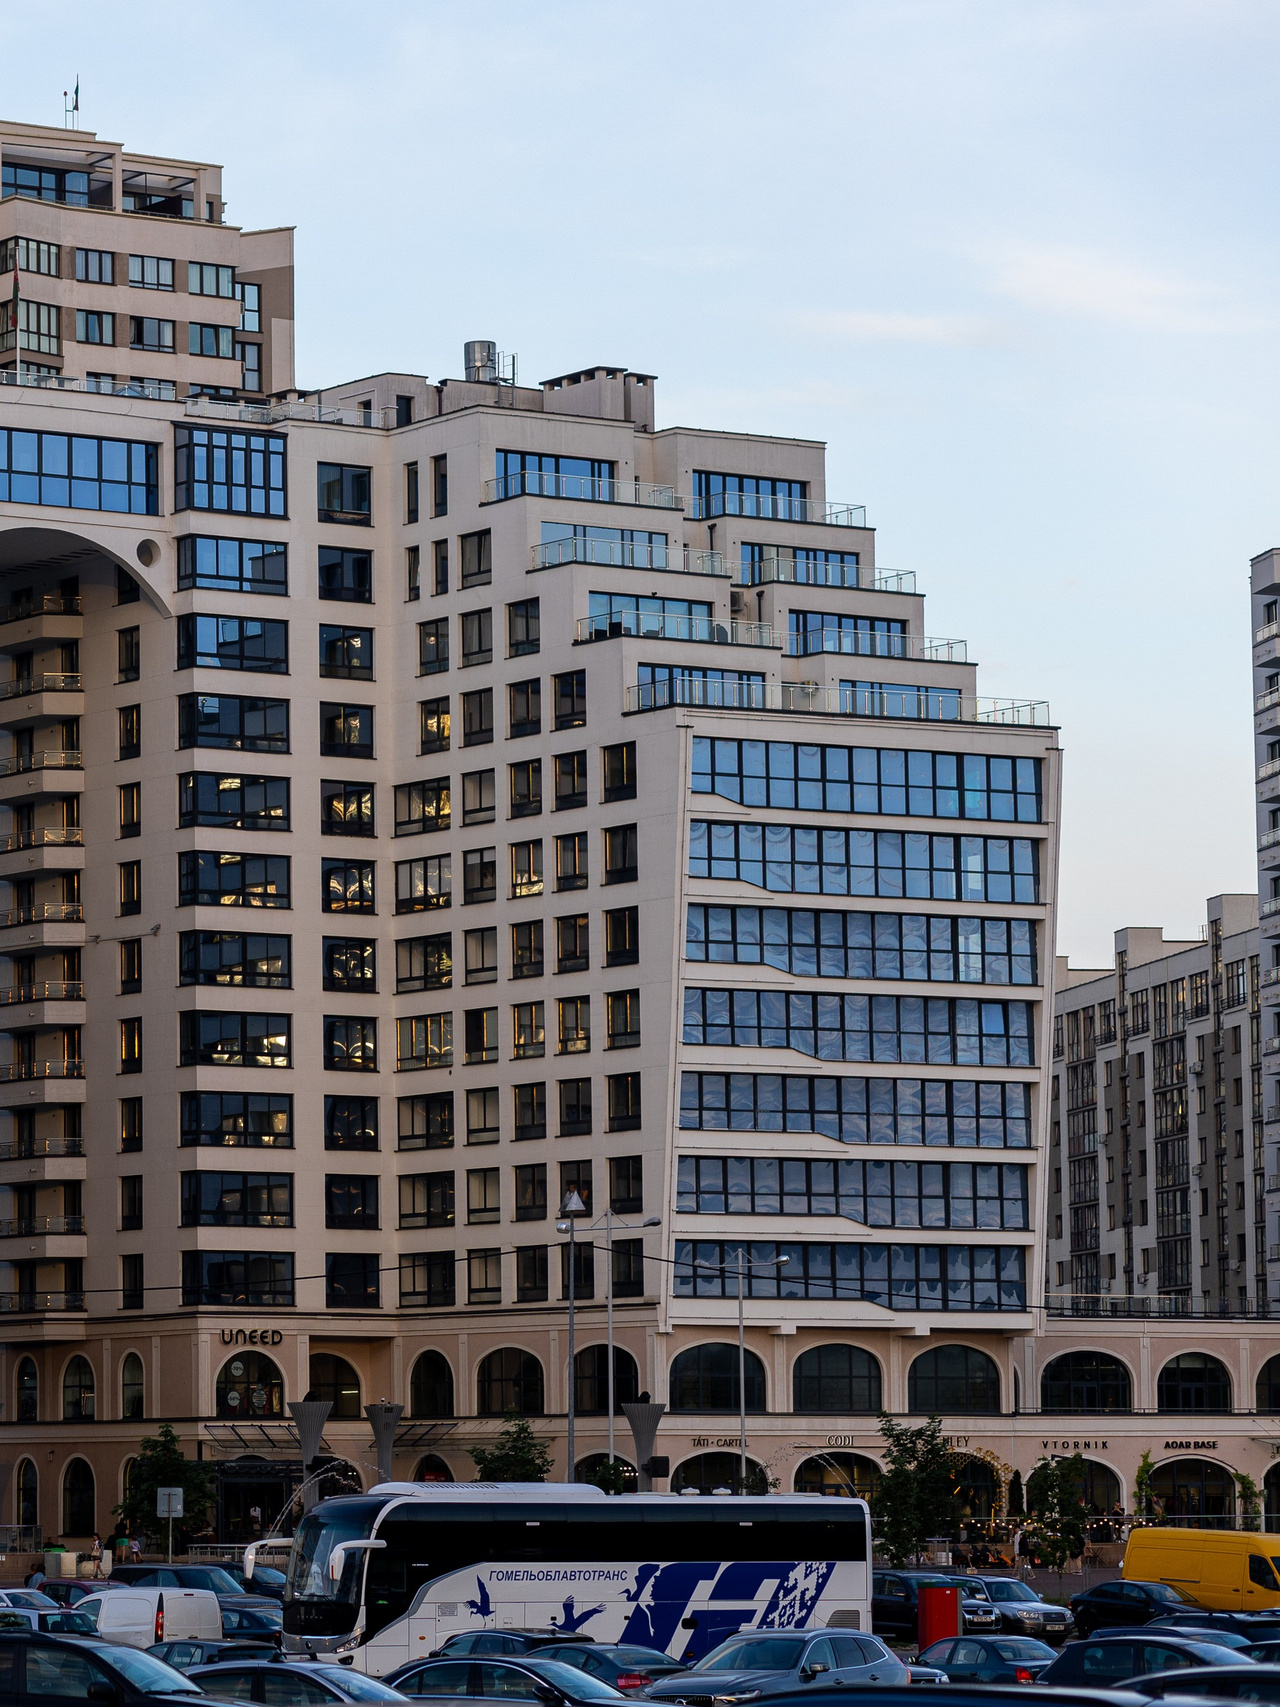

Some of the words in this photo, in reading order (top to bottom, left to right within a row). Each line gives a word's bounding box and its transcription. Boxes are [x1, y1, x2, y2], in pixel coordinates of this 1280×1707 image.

[222, 1329, 283, 1346] UNEED
[826, 1435, 854, 1447] CODI
[1042, 1440, 1109, 1450] VTORNIK
[1193, 1441, 1219, 1450] BASE
[489, 1569, 629, 1582] ГОМЕЛЬОБЛАВТОТРАНС
